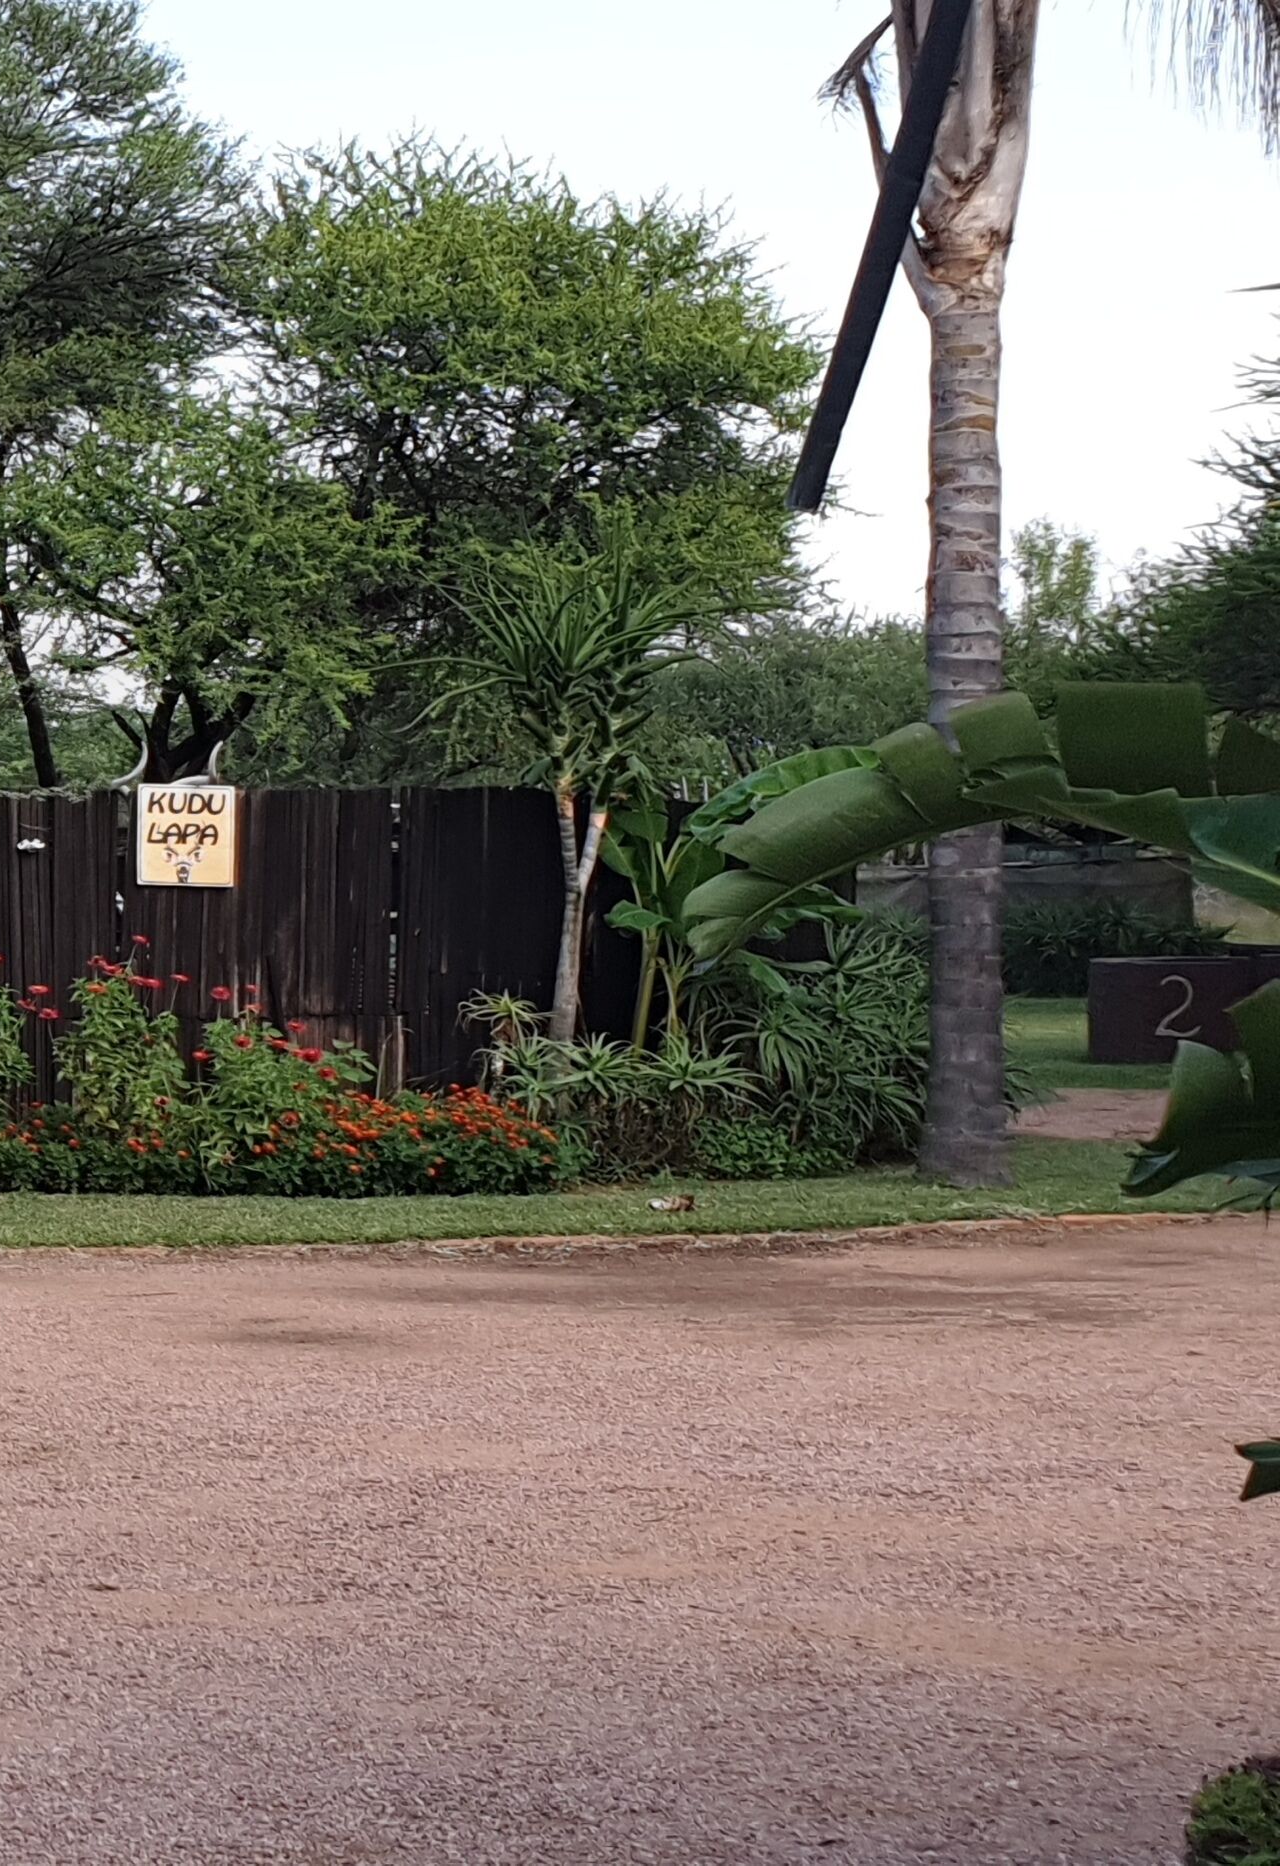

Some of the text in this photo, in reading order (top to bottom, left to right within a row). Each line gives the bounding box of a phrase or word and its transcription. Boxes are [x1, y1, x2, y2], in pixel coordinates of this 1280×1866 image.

[147, 792, 226, 815] KUDU
[147, 822, 219, 846] LAPA
[1154, 974, 1202, 1037] 2
